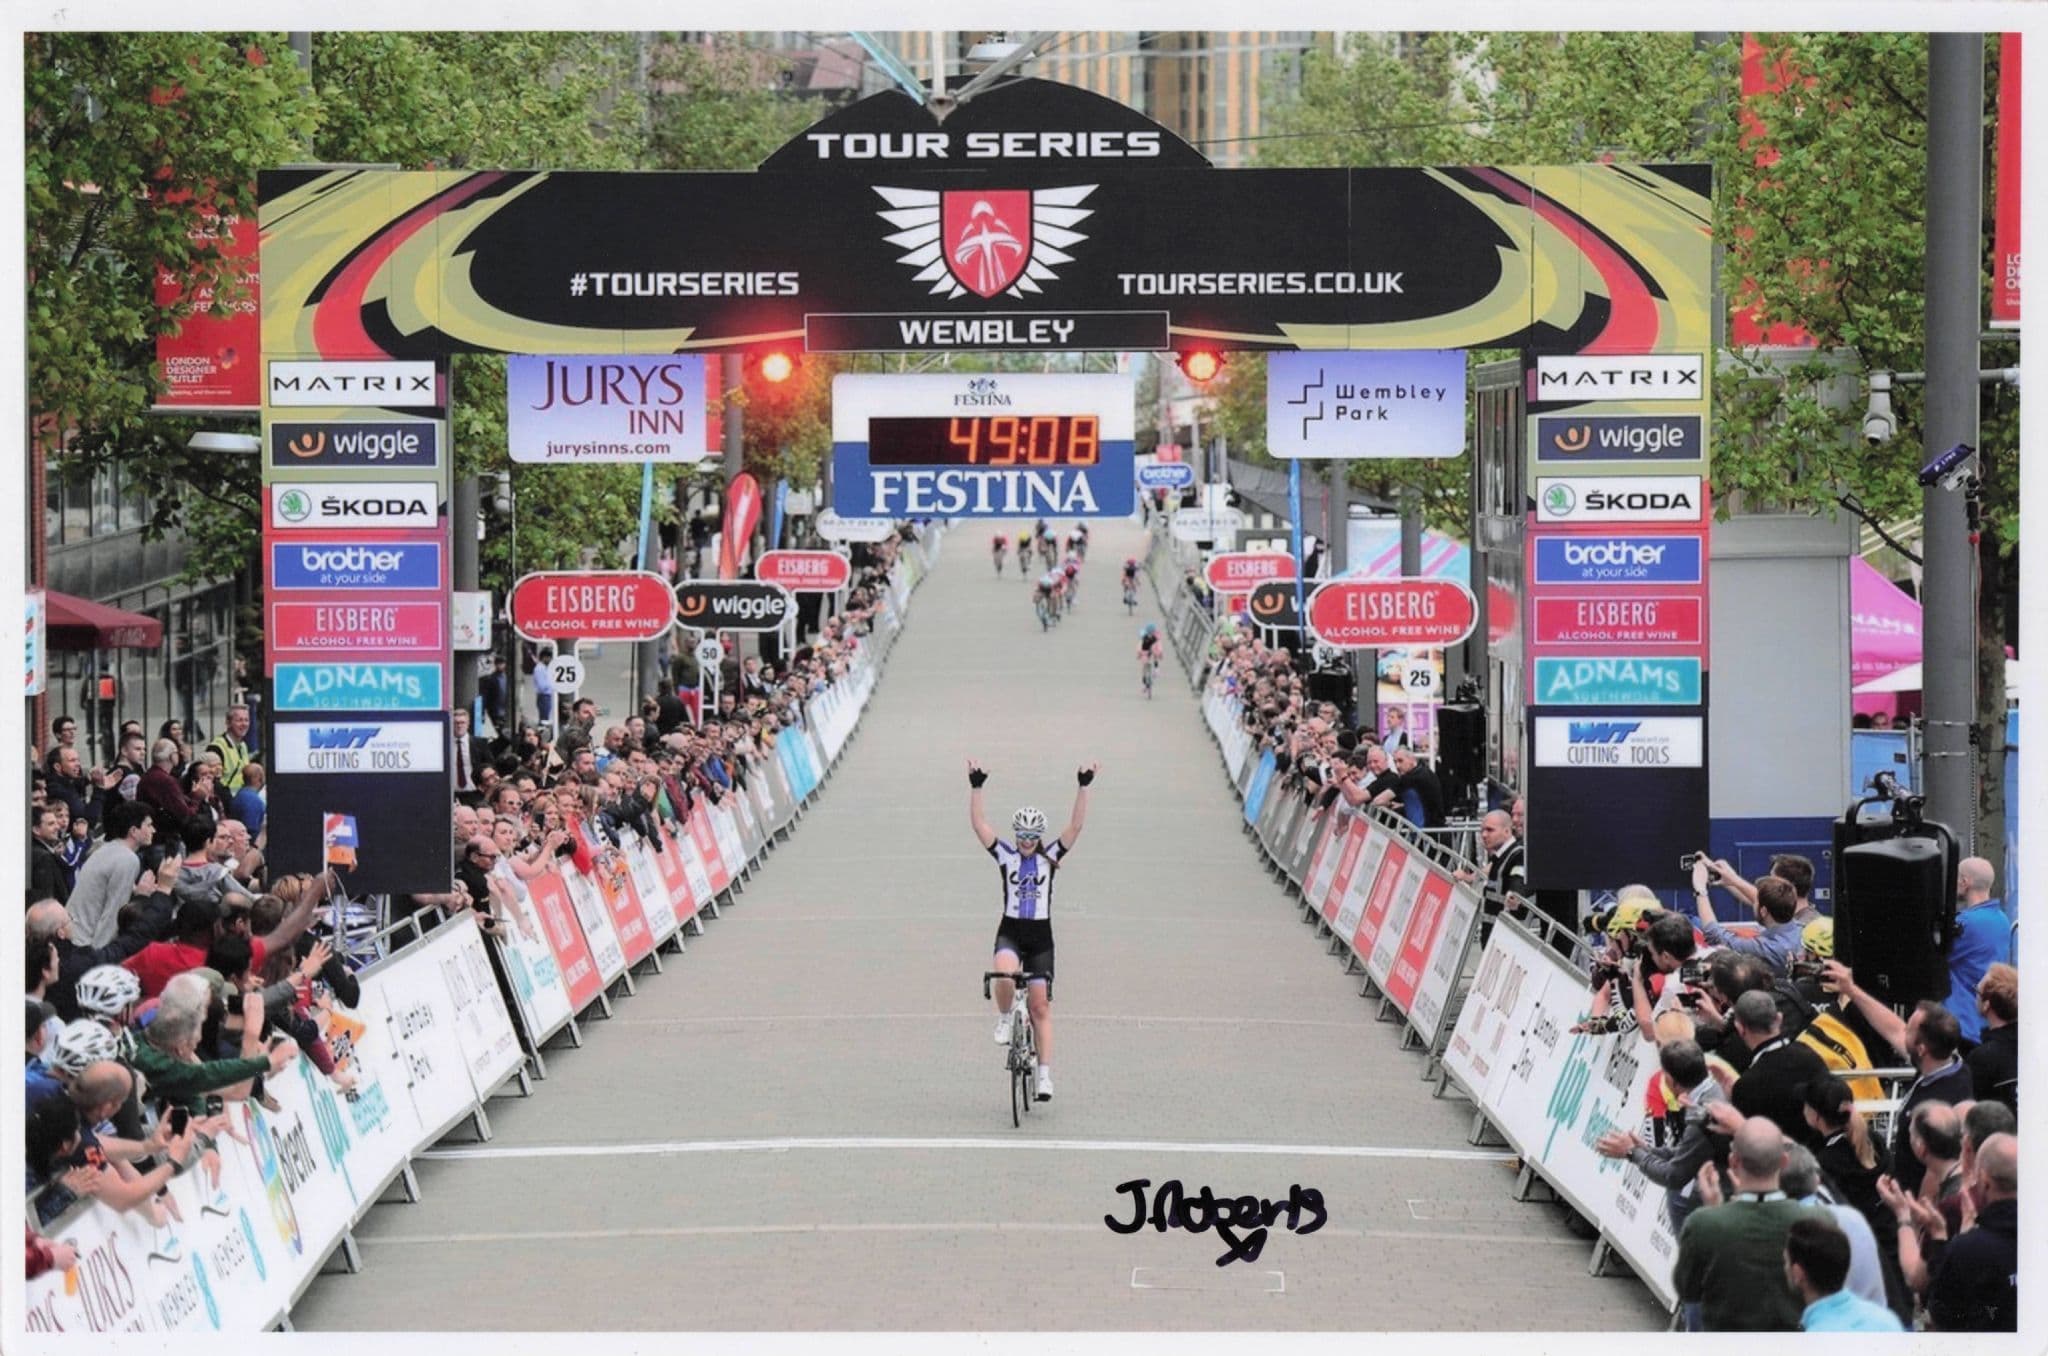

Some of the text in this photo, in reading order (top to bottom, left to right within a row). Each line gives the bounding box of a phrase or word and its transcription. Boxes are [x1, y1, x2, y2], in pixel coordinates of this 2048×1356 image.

[807, 131, 1161, 159] TOUR SERIES
[570, 271, 800, 298] #TOURSERIES
[1118, 271, 1404, 296] TOURSERIES.CO.UK
[899, 319, 1075, 345] WEMBLEY
[166, 357, 210, 366] LONDON
[166, 365, 217, 374] DESIGNER
[273, 376, 431, 391] MATRIX
[530, 361, 684, 410] JURYS
[1541, 370, 1697, 386] MATRIX
[953, 394, 1012, 406] FESTINA
[1335, 384, 1447, 402] Wembley
[630, 410, 684, 434] INN
[1335, 405, 1389, 421] Park
[333, 430, 420, 460] wiggle
[948, 415, 1098, 465] 49:08
[1599, 424, 1685, 452] wiggle
[546, 441, 671, 458] jurysinns.com
[869, 469, 1100, 514] FESTINA
[1585, 490, 1692, 510] ŠKODA
[321, 496, 428, 516] ŠKODA
[302, 547, 404, 571] brother
[1565, 541, 1666, 565] brother
[778, 558, 829, 576] EISBERG
[1227, 560, 1278, 577] EISBERG
[1582, 567, 1648, 580] at your side
[320, 573, 387, 586] at your side
[547, 586, 635, 613] EISBERG
[712, 594, 785, 619] wiggle
[1346, 591, 1436, 621] EISBERG
[316, 607, 396, 631] EISBERG
[1577, 601, 1657, 626] EISBERG
[524, 618, 661, 631] ALCOHOL FREE WINE
[1325, 624, 1460, 638] ALCOHOL FREE WINE
[296, 637, 418, 646] ALCOHOL FREE WINE
[1557, 631, 1678, 640] ALCOHOL FREE WINE
[703, 648, 717, 659] 50
[288, 665, 422, 702] ADNAMS
[555, 666, 576, 684] 25
[1410, 669, 1431, 687] 25
[1547, 660, 1680, 697] ADNAMS
[307, 750, 412, 769] CUTTING TOOLS
[1567, 745, 1671, 764] CUTTING TOOLS
